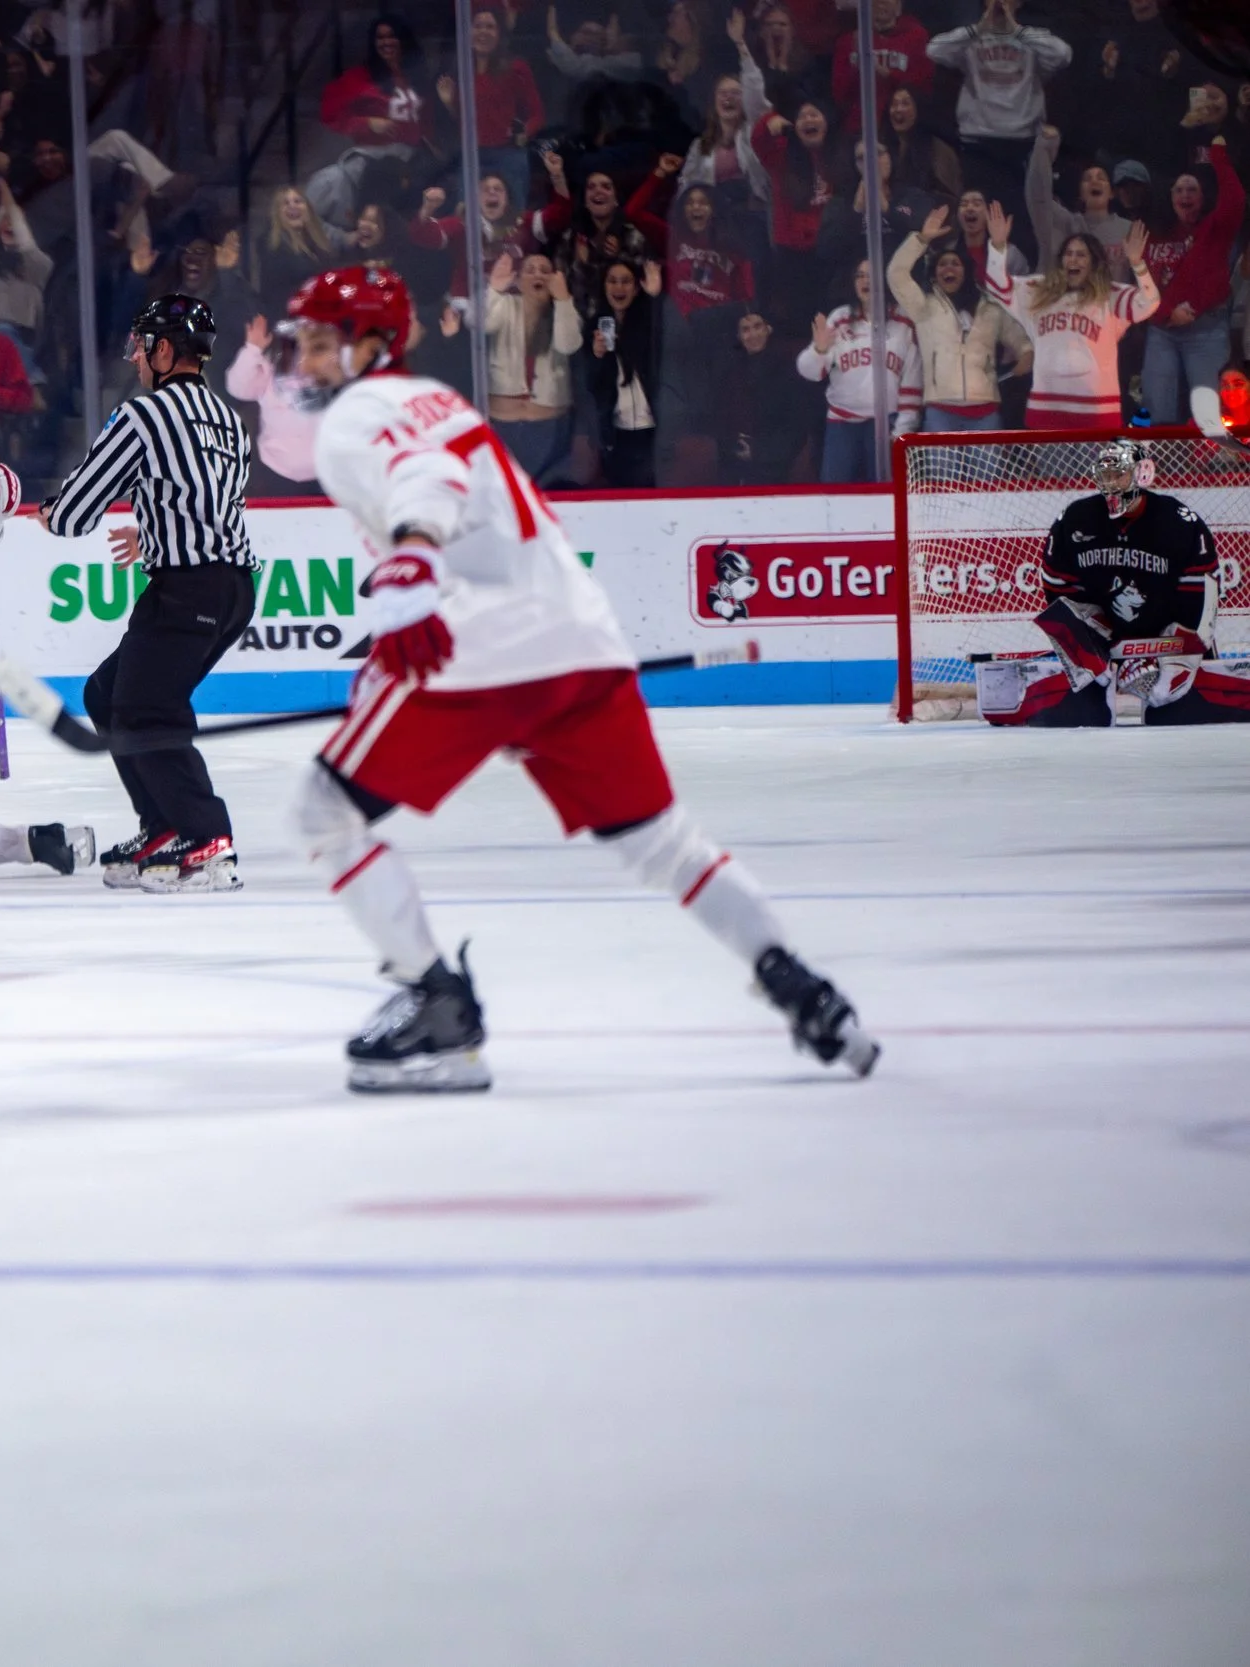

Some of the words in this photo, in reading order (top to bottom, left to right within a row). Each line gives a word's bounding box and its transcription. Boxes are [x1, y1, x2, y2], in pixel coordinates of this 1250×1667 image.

[1036, 312, 1101, 344] BOSTON
[839, 348, 905, 376] BOSON
[192, 422, 237, 458] VALLE
[768, 551, 1041, 598] GoTeriers.c
[1077, 547, 1169, 574] NORTHEASTERN
[238, 624, 342, 651] AUTO
